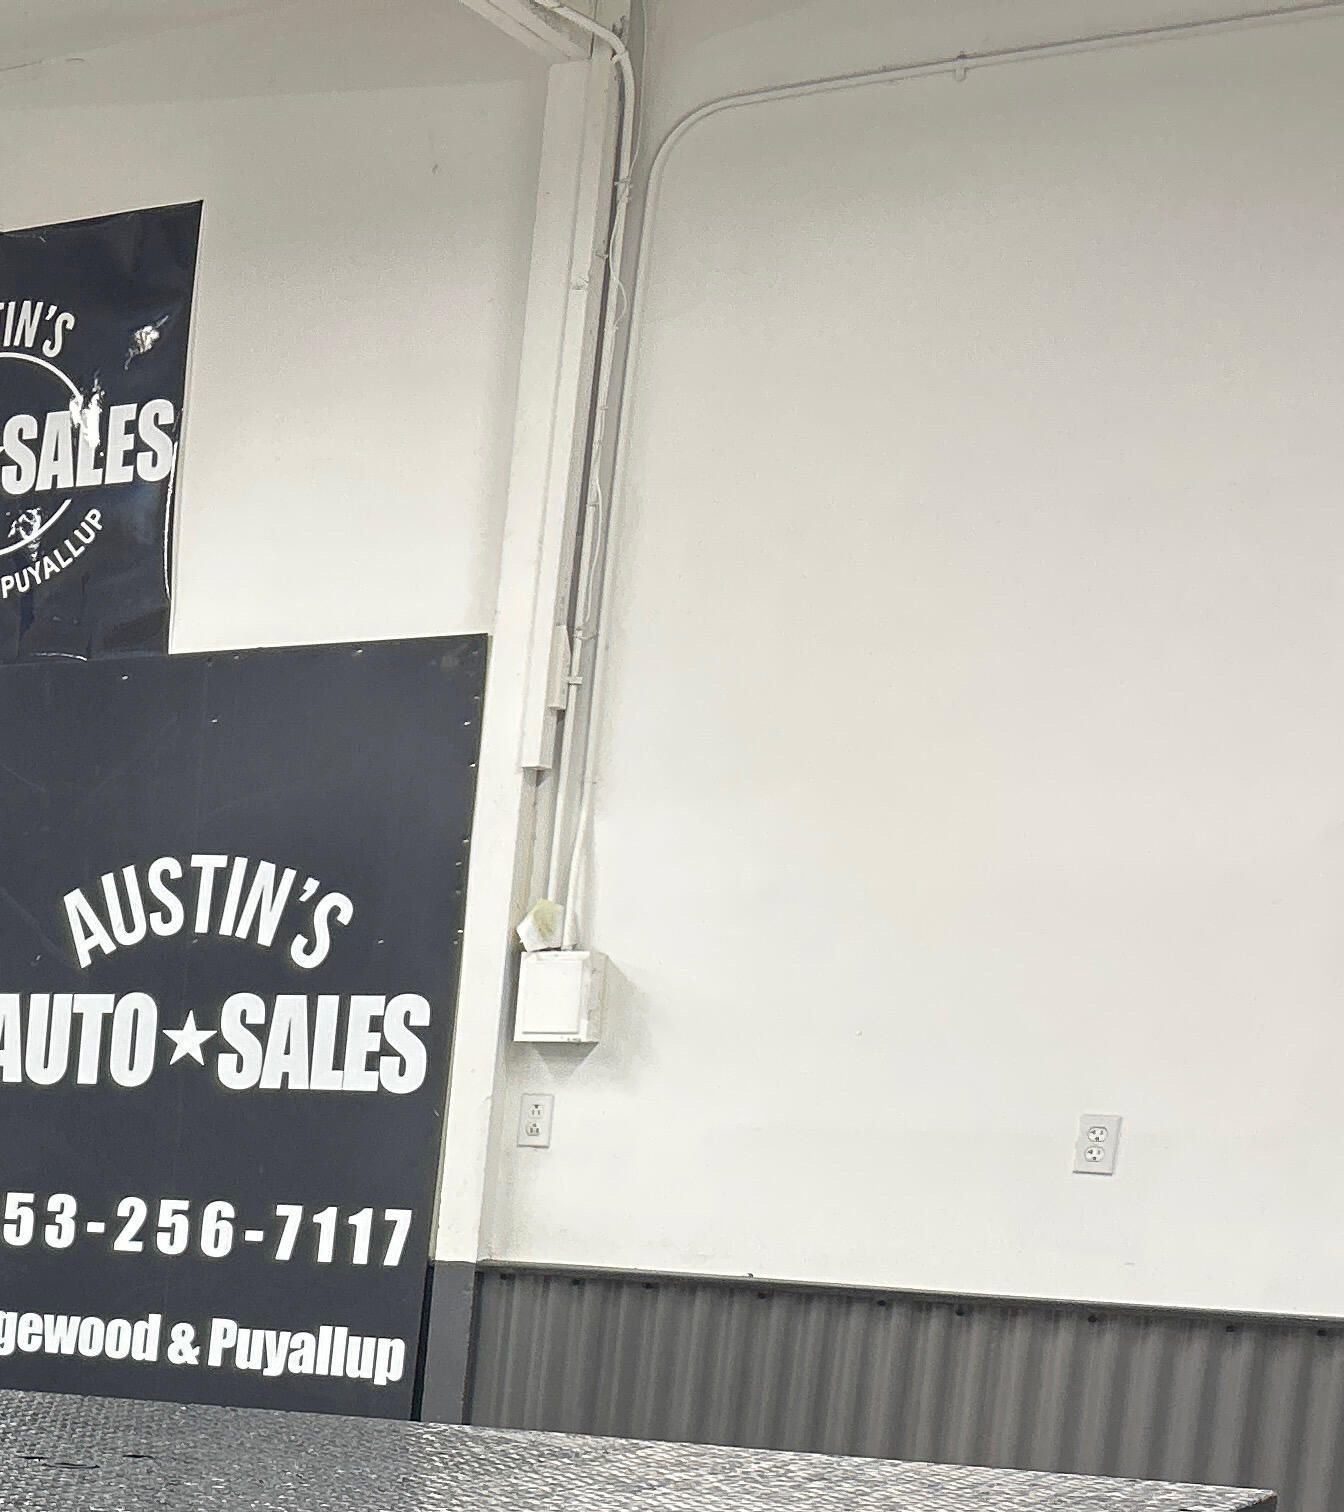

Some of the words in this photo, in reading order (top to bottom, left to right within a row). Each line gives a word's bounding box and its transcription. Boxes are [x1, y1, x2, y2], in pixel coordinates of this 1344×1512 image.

[1, 399, 176, 496] SALES
[1, 508, 103, 599] PUYALLUP
[63, 854, 354, 969] AUSTIN'S
[217, 992, 432, 1094] SALES
[167, 1321, 201, 1365] &
[207, 1316, 406, 1386] Puyallup
